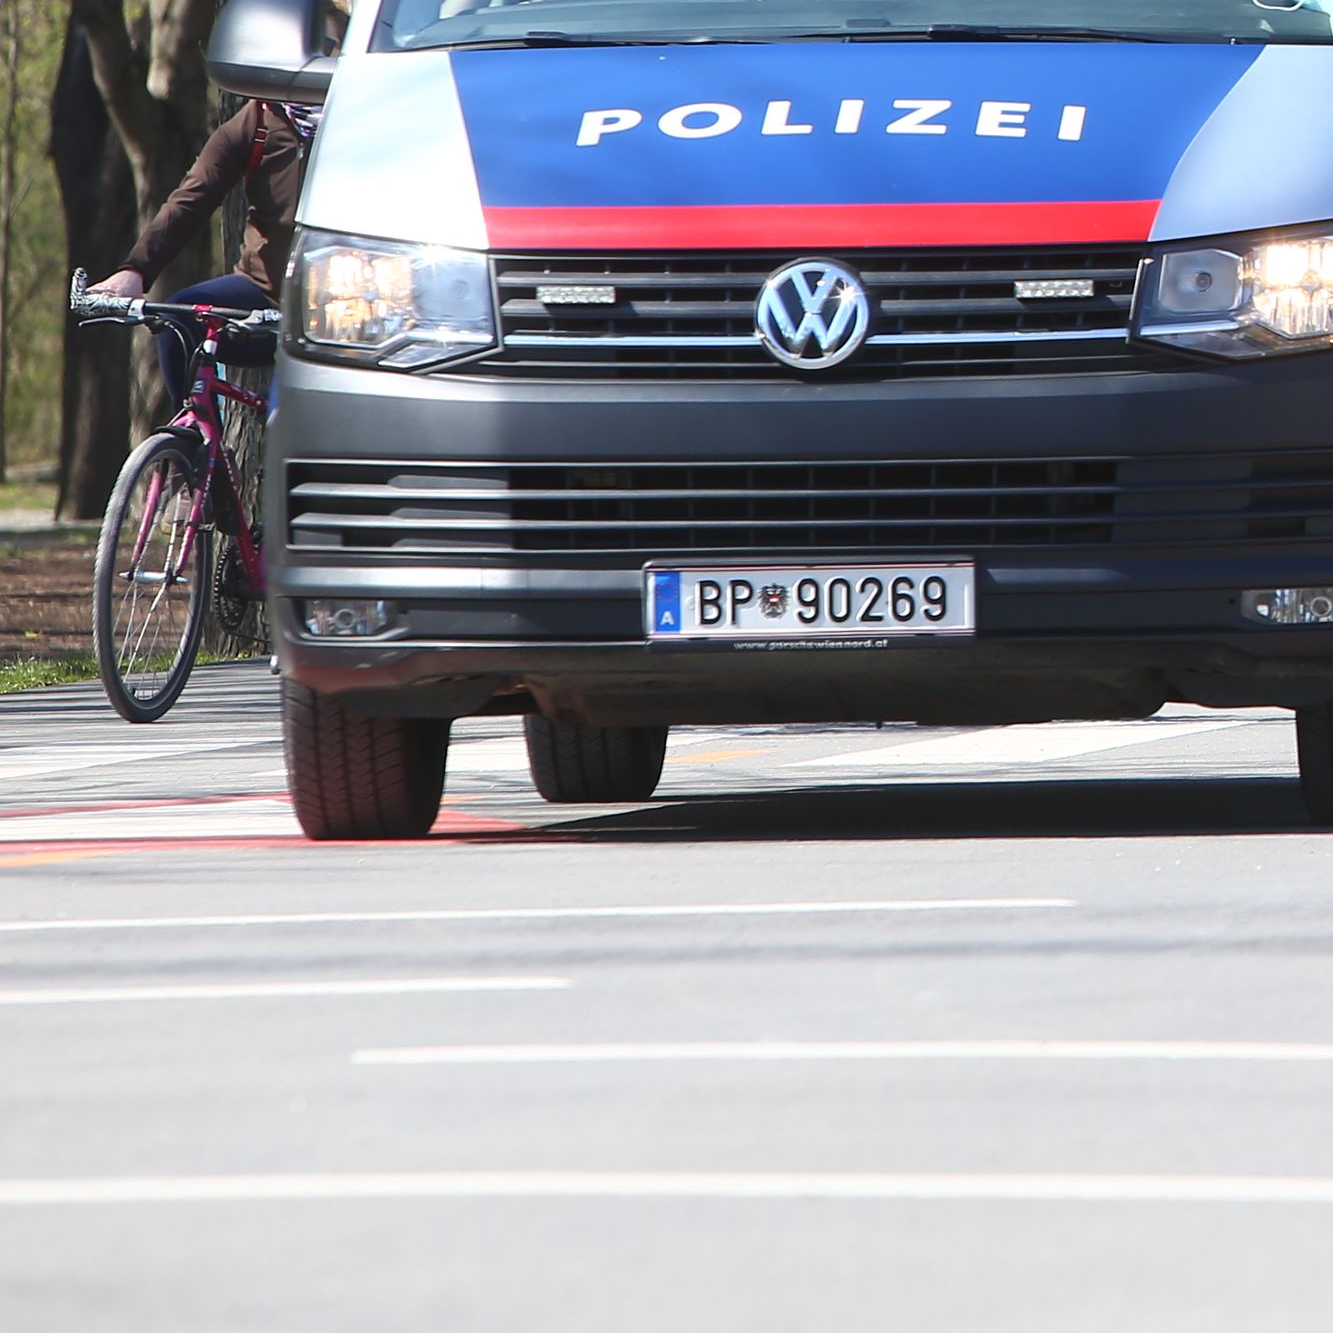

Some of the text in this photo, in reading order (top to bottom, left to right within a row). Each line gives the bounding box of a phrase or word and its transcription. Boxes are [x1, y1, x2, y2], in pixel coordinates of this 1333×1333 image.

[575, 98, 1087, 147] POLIZEI
[757, 260, 869, 369] VW
[660, 611, 675, 626] A
[696, 575, 947, 626] BP 90269
